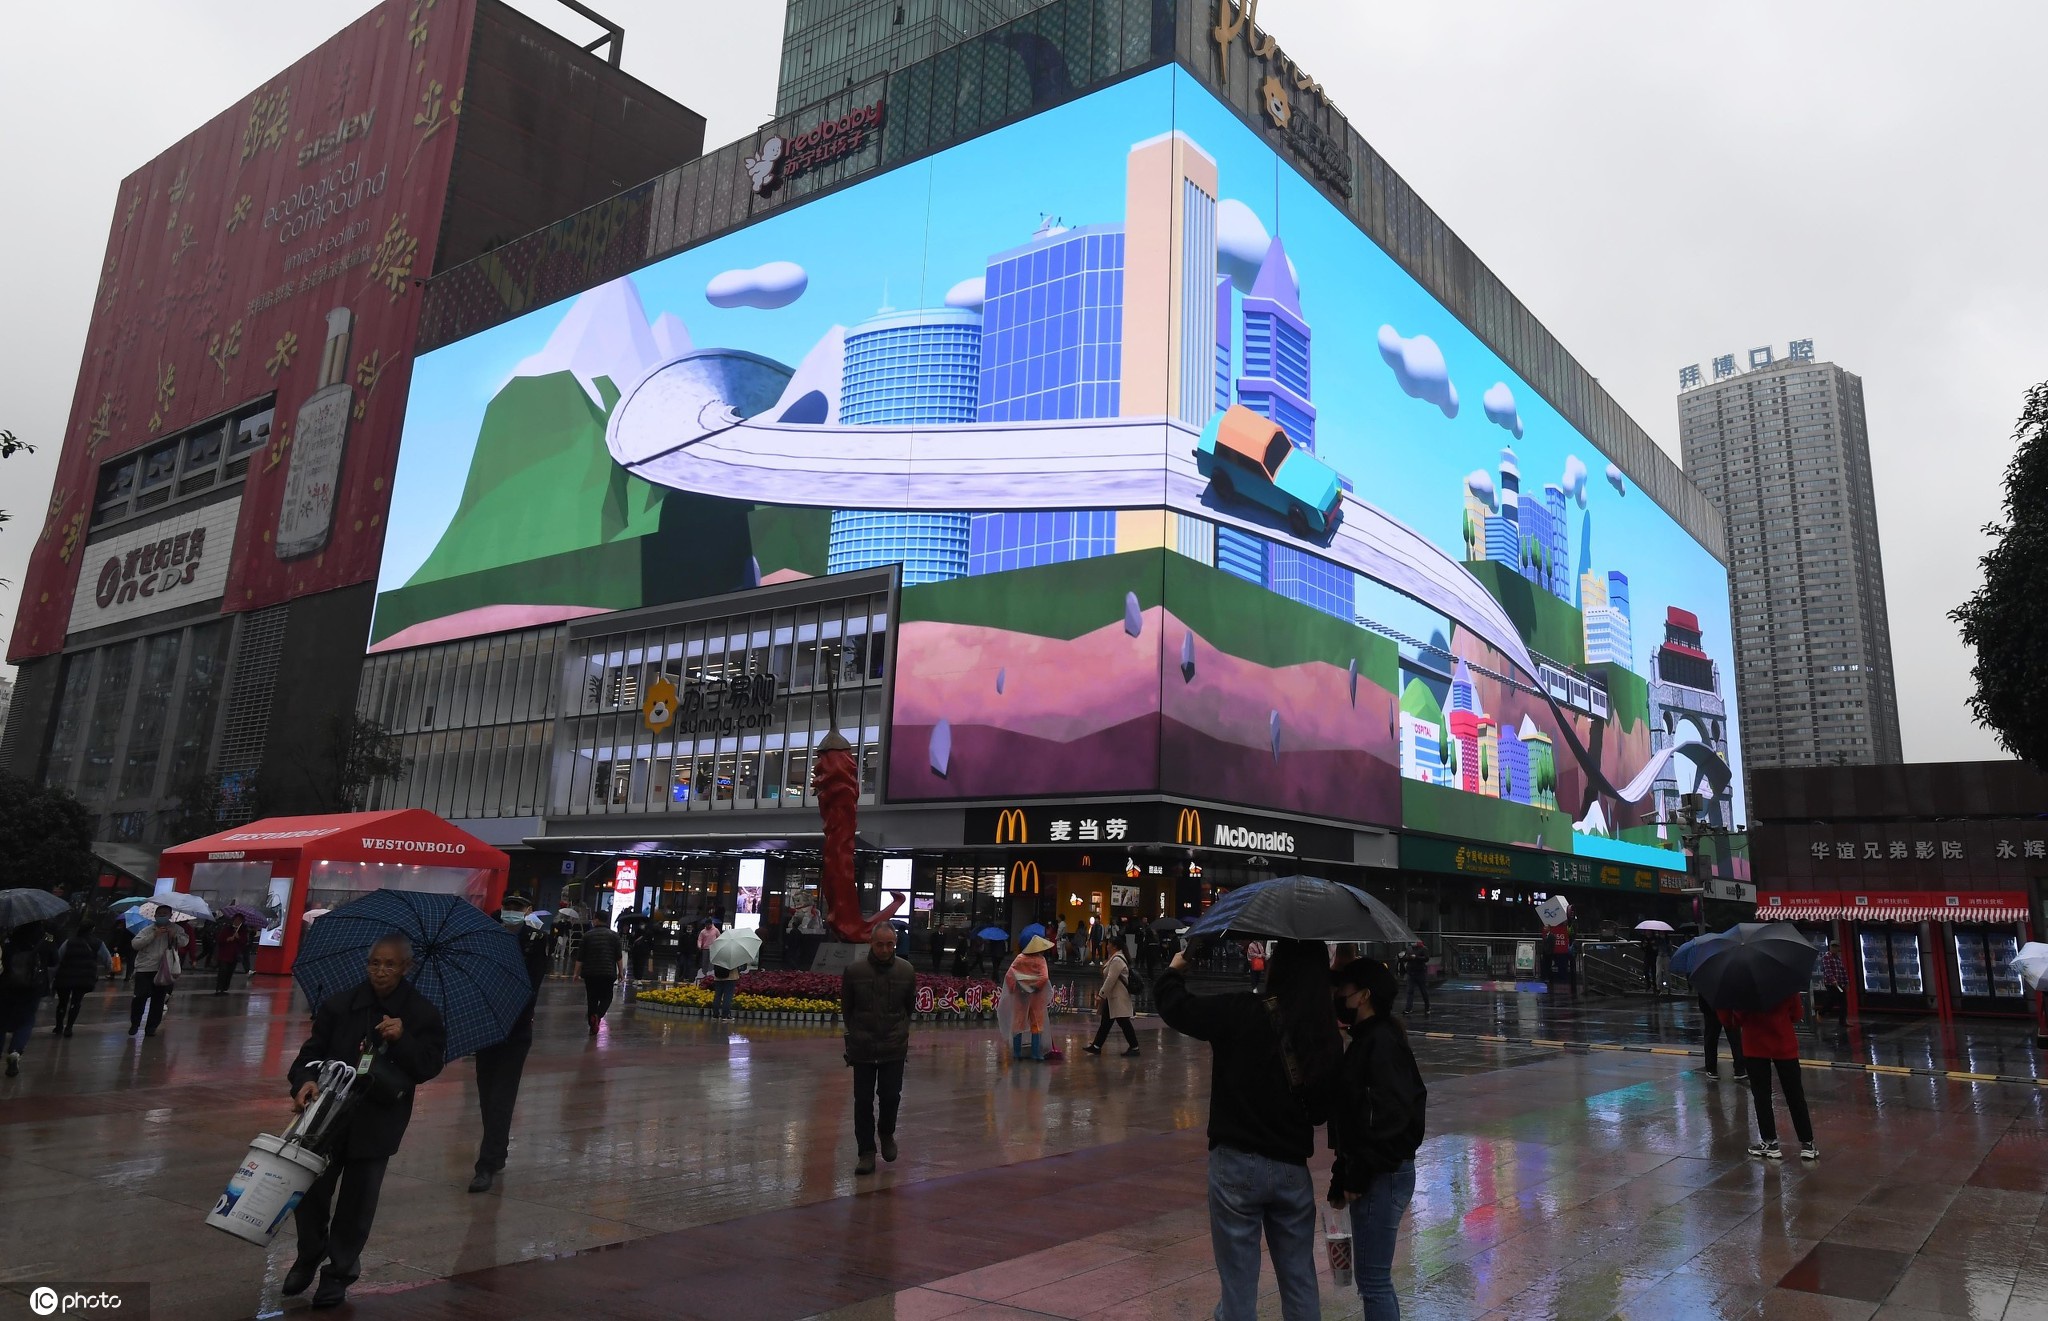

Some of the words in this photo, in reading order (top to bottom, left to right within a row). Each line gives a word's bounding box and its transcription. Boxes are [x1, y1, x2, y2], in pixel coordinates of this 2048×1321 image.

[297, 104, 376, 167] sisley
[783, 98, 884, 157] redbaby
[783, 130, 864, 177] 苏宁红孩子
[264, 151, 361, 228] ecological
[280, 162, 387, 243] compound
[325, 218, 370, 253] edition
[1680, 337, 1814, 391] 拜博口腔
[122, 527, 206, 581] 新世纪百货
[681, 673, 777, 713] 苏宁易购
[680, 711, 773, 737] suning.com
[1412, 722, 1432, 738] OSPITAL
[362, 837, 467, 855] WESTONBOLO
[1050, 818, 1129, 842] 麦当劳
[1215, 823, 1295, 854] McDonald's
[1811, 840, 1964, 860] 华谊兄弟影院
[1996, 839, 2048, 860] 永辉
